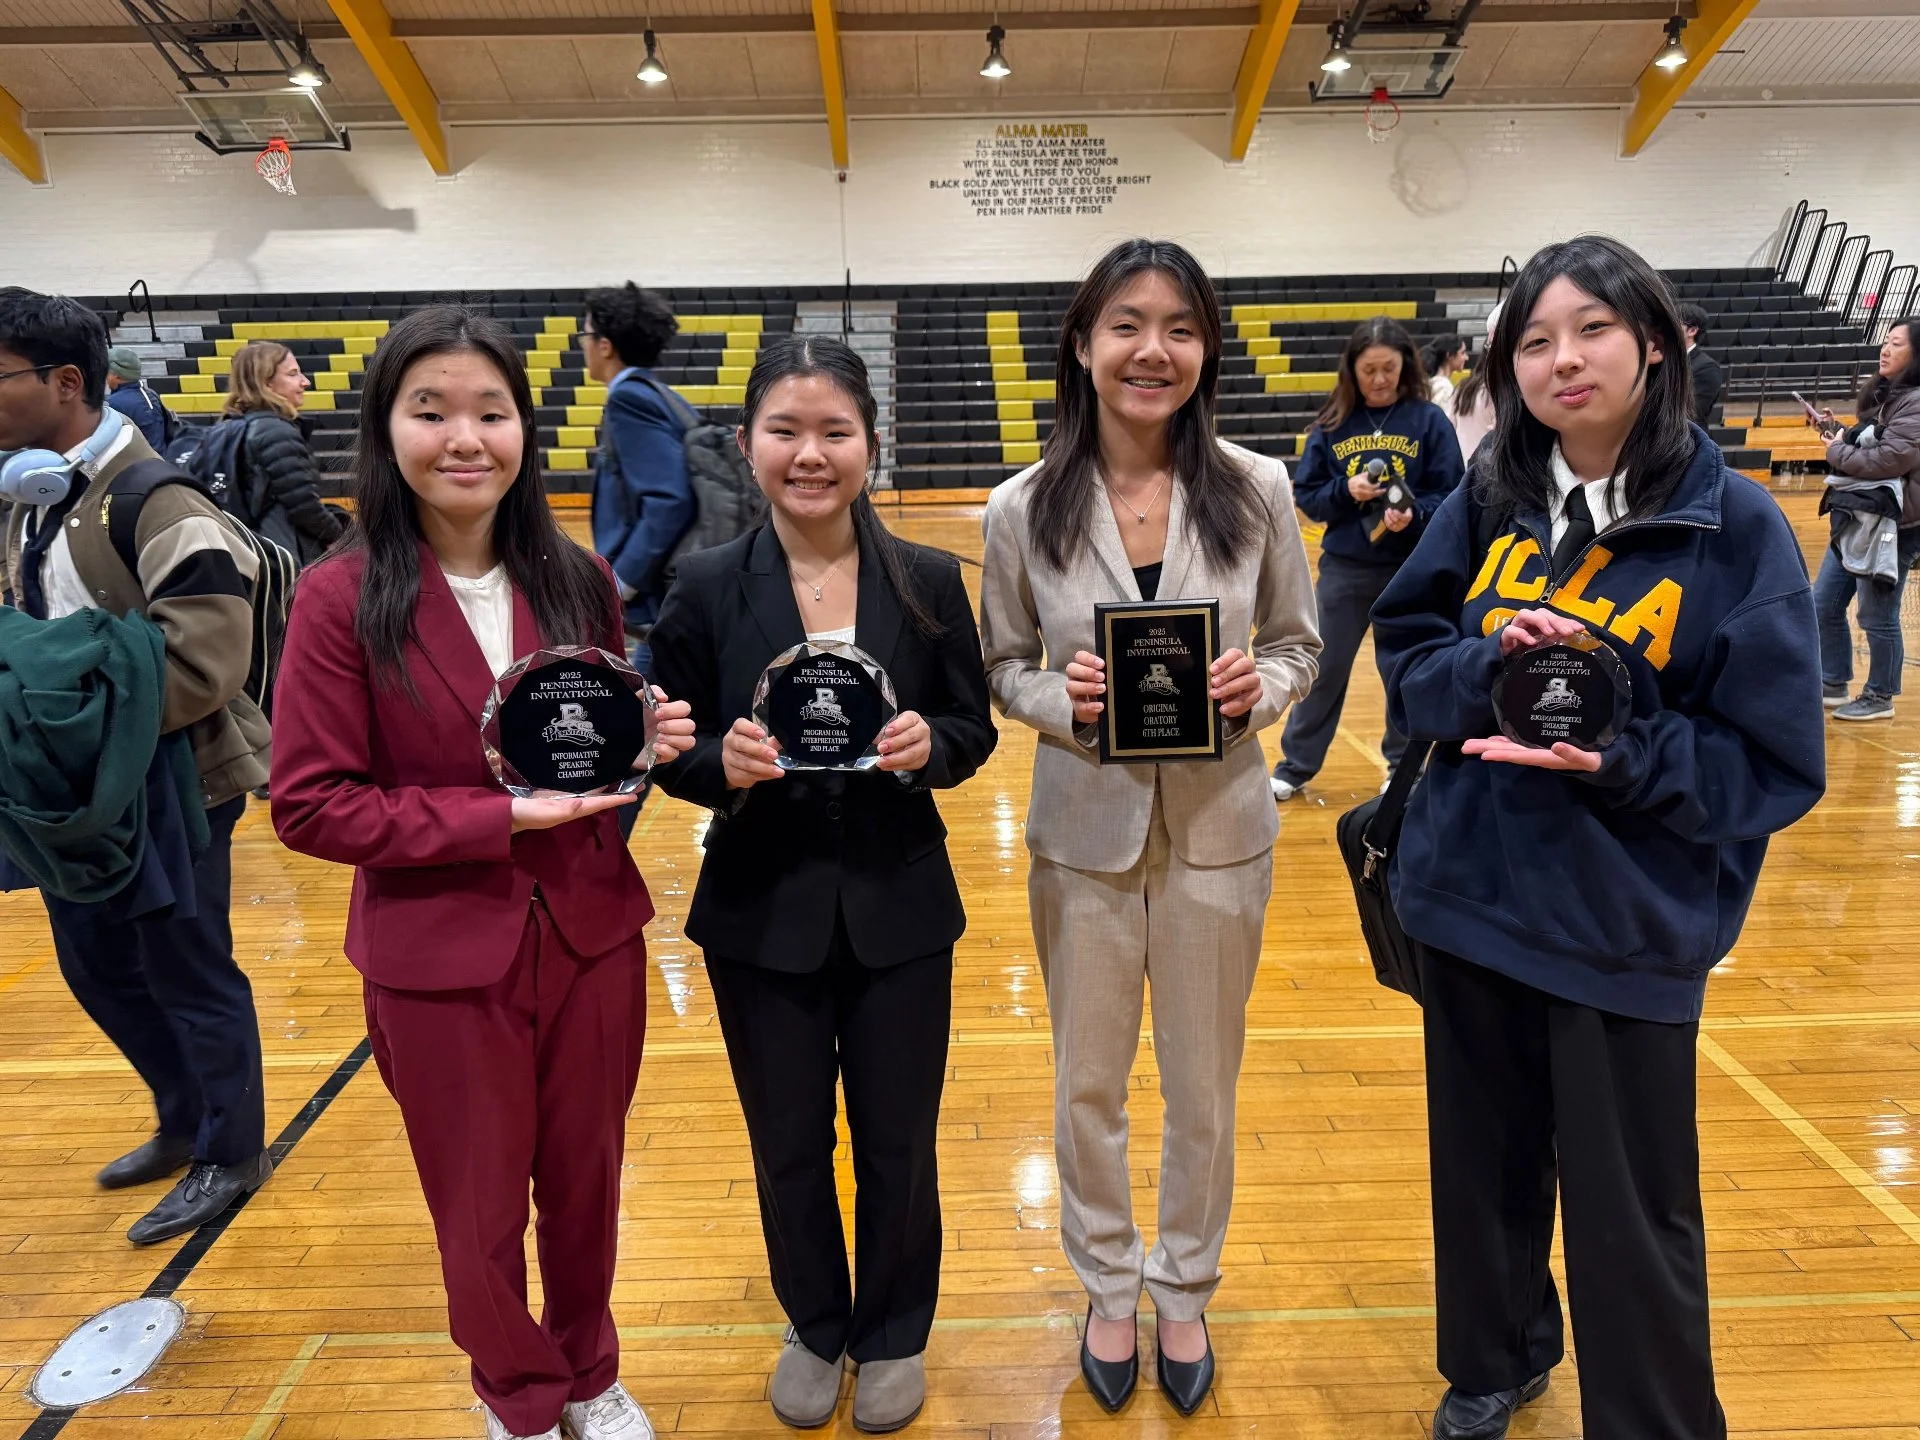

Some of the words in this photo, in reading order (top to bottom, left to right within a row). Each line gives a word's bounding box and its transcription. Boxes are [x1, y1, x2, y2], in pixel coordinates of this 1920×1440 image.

[996, 124, 1037, 138] ALMA
[1041, 124, 1088, 138] MATER
[976, 140, 992, 148] ALL
[996, 139, 1017, 148] HAIL
[1021, 139, 1033, 148] TO
[1037, 139, 1066, 148] ALMA
[1070, 138, 1105, 147] MATER
[976, 150, 988, 158] TO
[991, 149, 1046, 158] PENINSULA
[1050, 148, 1079, 157] WE'RE
[1083, 148, 1107, 157] TRUE
[963, 160, 989, 169] WITH
[992, 159, 1006, 168] ALL
[1010, 159, 1029, 168] OUR
[1033, 158, 1059, 167] PRIDE
[1062, 158, 1082, 167] AND
[1085, 157, 1118, 166] HONOR
[975, 169, 992, 178] WE
[994, 169, 1019, 177] WILL
[1023, 168, 1057, 177] PLEDGE
[1061, 168, 1074, 176] TO
[1077, 167, 1100, 176] YOU
[929, 180, 960, 189] BLACK
[963, 179, 988, 188] GOLD
[990, 179, 1009, 188] AND
[1011, 178, 1044, 187] WHITE
[1048, 177, 1068, 186] OUR
[1072, 176, 1112, 186] COLORS
[1117, 175, 1151, 185] BRIGHT
[963, 189, 999, 198] UNITED
[1002, 188, 1018, 197] WE
[1022, 187, 1053, 196] STAND
[1057, 187, 1076, 195] SIDE
[1080, 186, 1093, 195] BY
[1096, 186, 1117, 195] SIDE
[971, 199, 991, 207] AND
[993, 198, 1003, 206] IN
[1007, 198, 1027, 206] OUR
[1030, 197, 1066, 206] HEARTS
[1070, 195, 1113, 205] FOREVER
[976, 207, 996, 216] PEN
[1000, 207, 1024, 216] HIGH
[1027, 206, 1072, 215] PANTHER
[1076, 205, 1103, 214] PRIDE
[1332, 434, 1420, 461] PENINSULA
[1149, 628, 1166, 636] 2025
[1134, 637, 1182, 647] PENINSULA
[1127, 646, 1190, 657] INVITATIONAL
[559, 671, 581, 680] 2025
[801, 668, 851, 677] PENINSULA
[539, 680, 602, 690] PENINSULA
[793, 676, 859, 685] INVITATIONAL
[530, 689, 613, 700] INVITATIONAL
[1143, 703, 1178, 713] ORIGINAL
[1144, 715, 1178, 726] ORATORY
[803, 729, 831, 737] PROGRAM
[832, 729, 848, 737] ORAL
[1142, 728, 1157, 737] 6TH
[1158, 727, 1180, 737] PLACE
[801, 737, 850, 745] INTERPRETATION
[552, 751, 600, 761] INFORMATIVE
[558, 760, 593, 770] SPEAKING
[557, 769, 595, 779] CHAMPION
